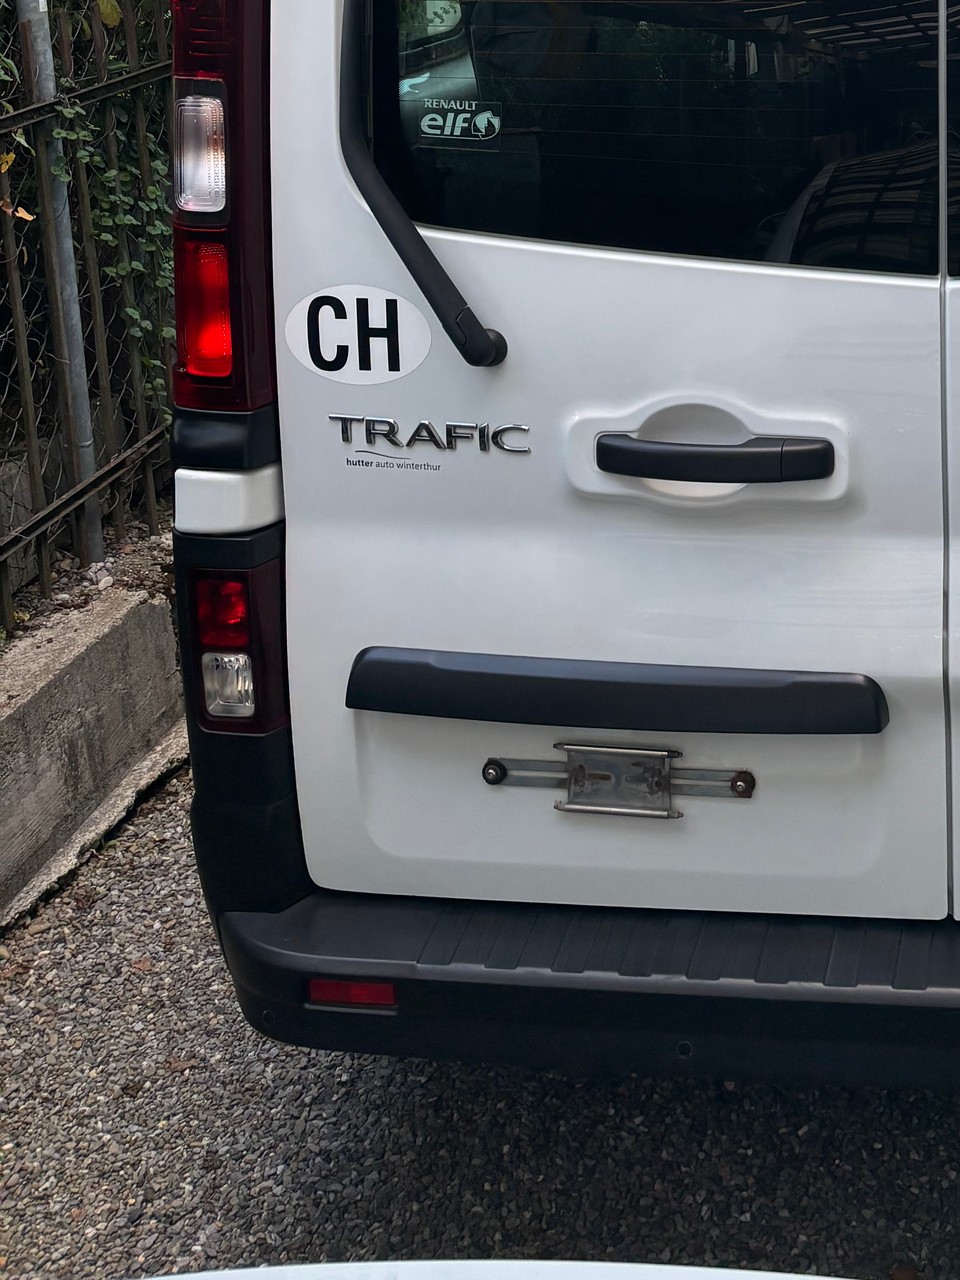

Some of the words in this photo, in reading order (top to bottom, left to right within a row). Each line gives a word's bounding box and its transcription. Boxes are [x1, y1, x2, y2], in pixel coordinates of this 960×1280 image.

[424, 98, 478, 111] RENAULT
[420, 112, 471, 136] elf
[306, 295, 401, 373] CH
[328, 412, 532, 454] TRAFIC
[346, 457, 374, 468] hutter
[375, 460, 395, 469] auto
[396, 460, 441, 471] winterthur
